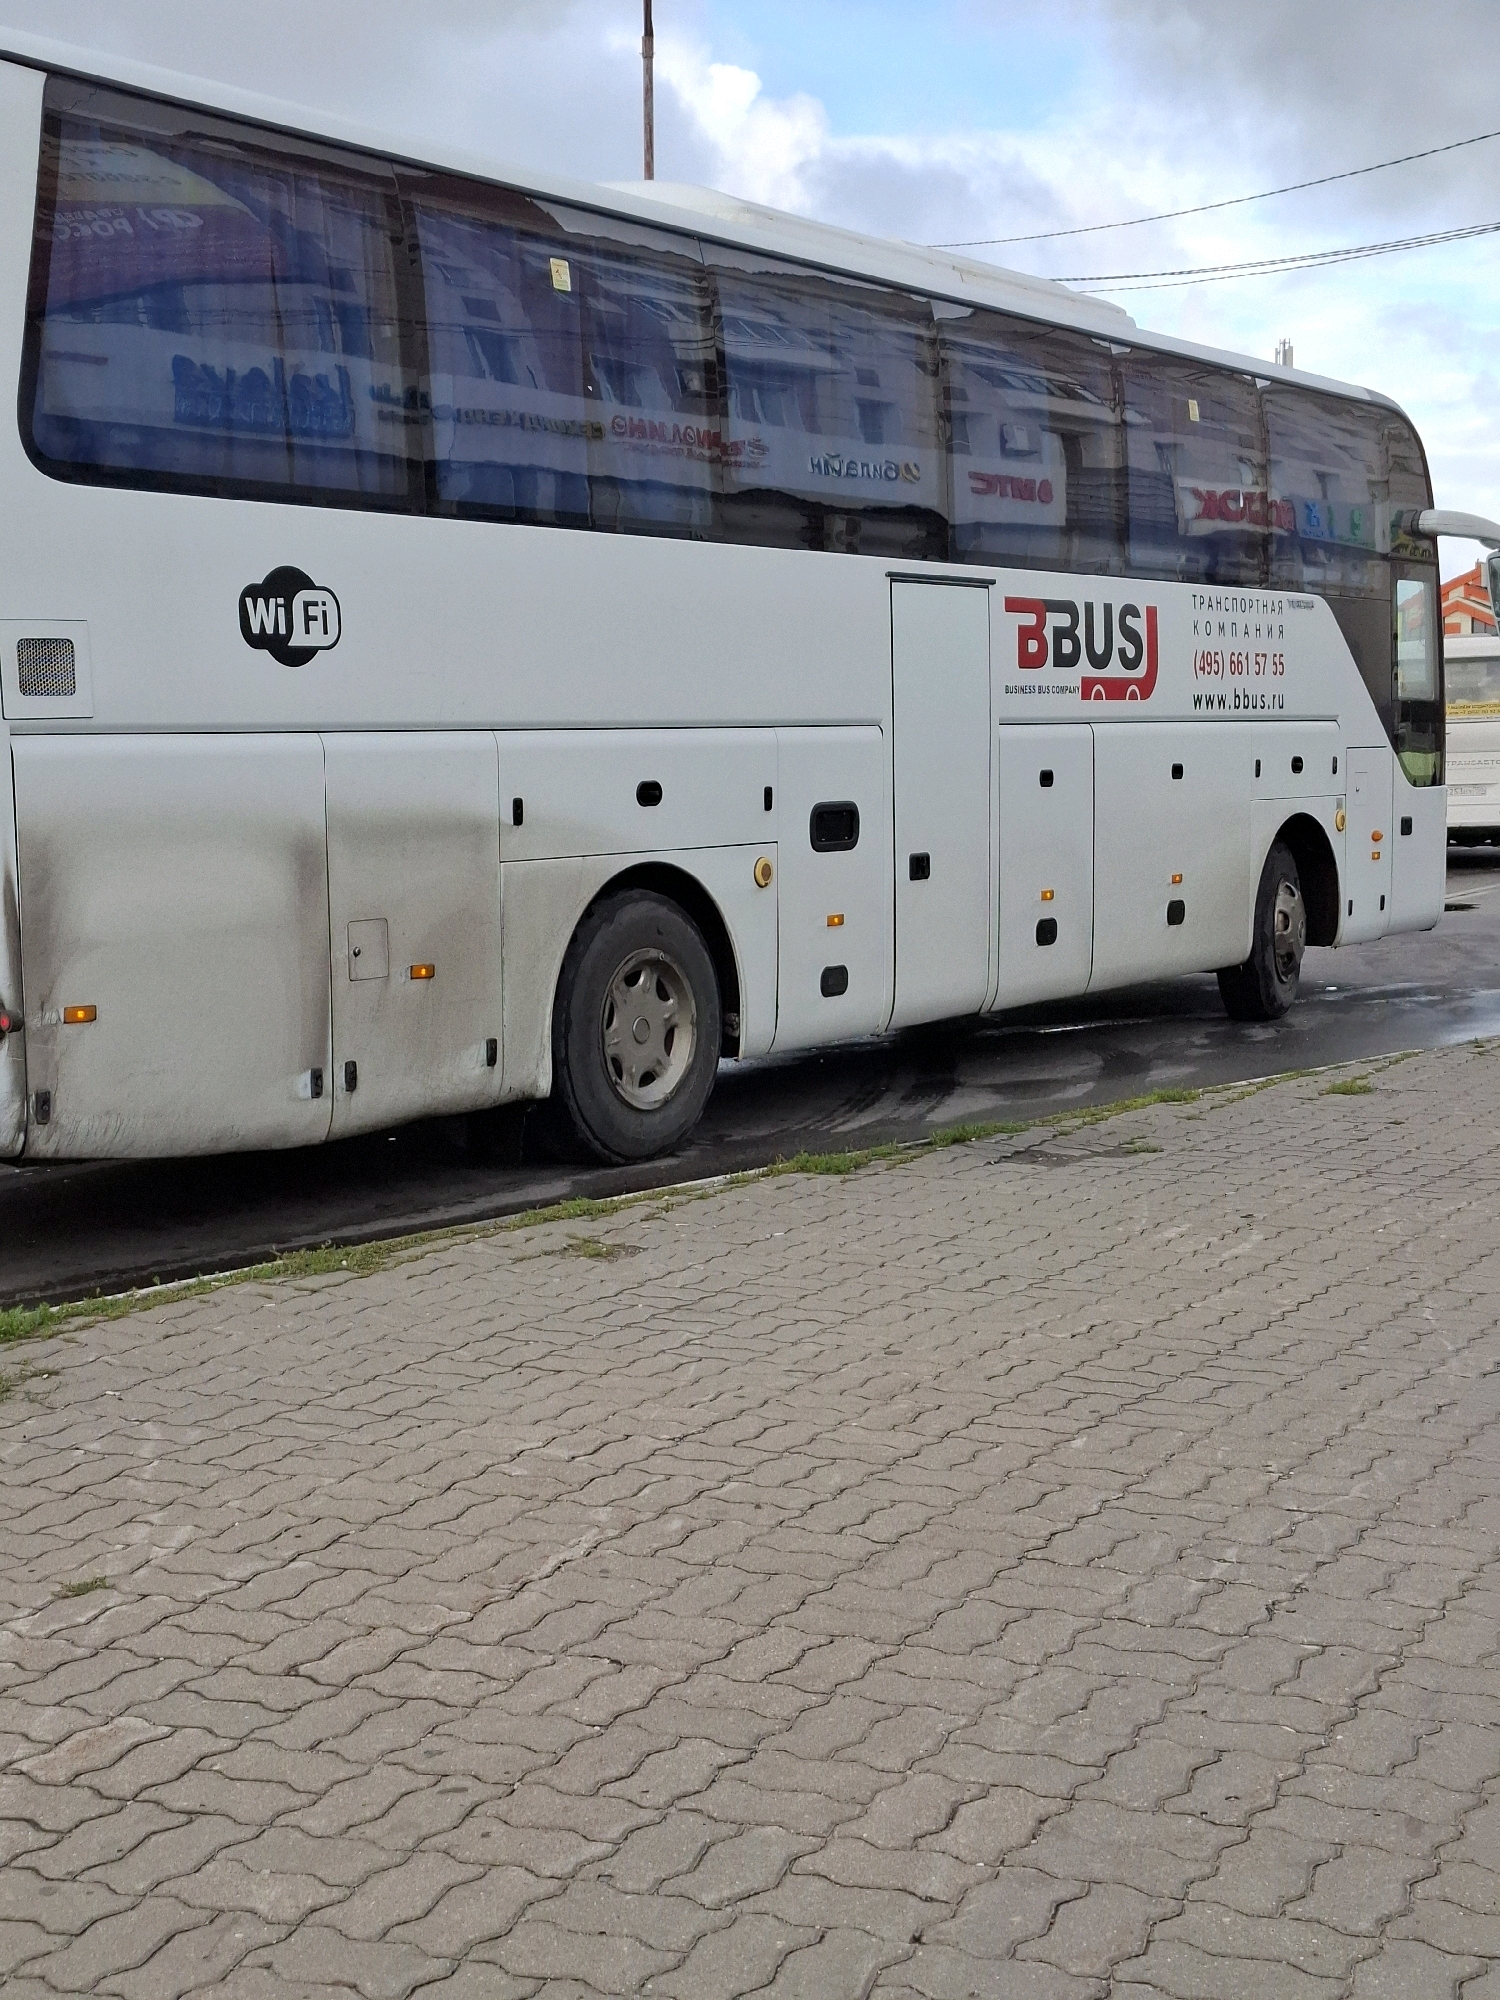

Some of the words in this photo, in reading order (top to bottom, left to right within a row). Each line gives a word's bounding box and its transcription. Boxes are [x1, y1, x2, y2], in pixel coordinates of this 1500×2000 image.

[245, 597, 286, 634] Wi
[303, 600, 329, 635] Fi
[1192, 594, 1284, 615] ТРАНСПОРТНАЯ
[1004, 596, 1144, 670] BBUS
[1193, 619, 1284, 639] КОМПАНИЯ
[1193, 648, 1225, 680] (495)
[1229, 651, 1250, 676] 661
[1254, 652, 1268, 676] 57
[1272, 653, 1285, 676] 55
[1005, 684, 1036, 695] BUSINESS
[1037, 684, 1051, 695] BUS
[1051, 685, 1080, 695] COMPANY
[1193, 687, 1284, 710] www.bbus.ru
